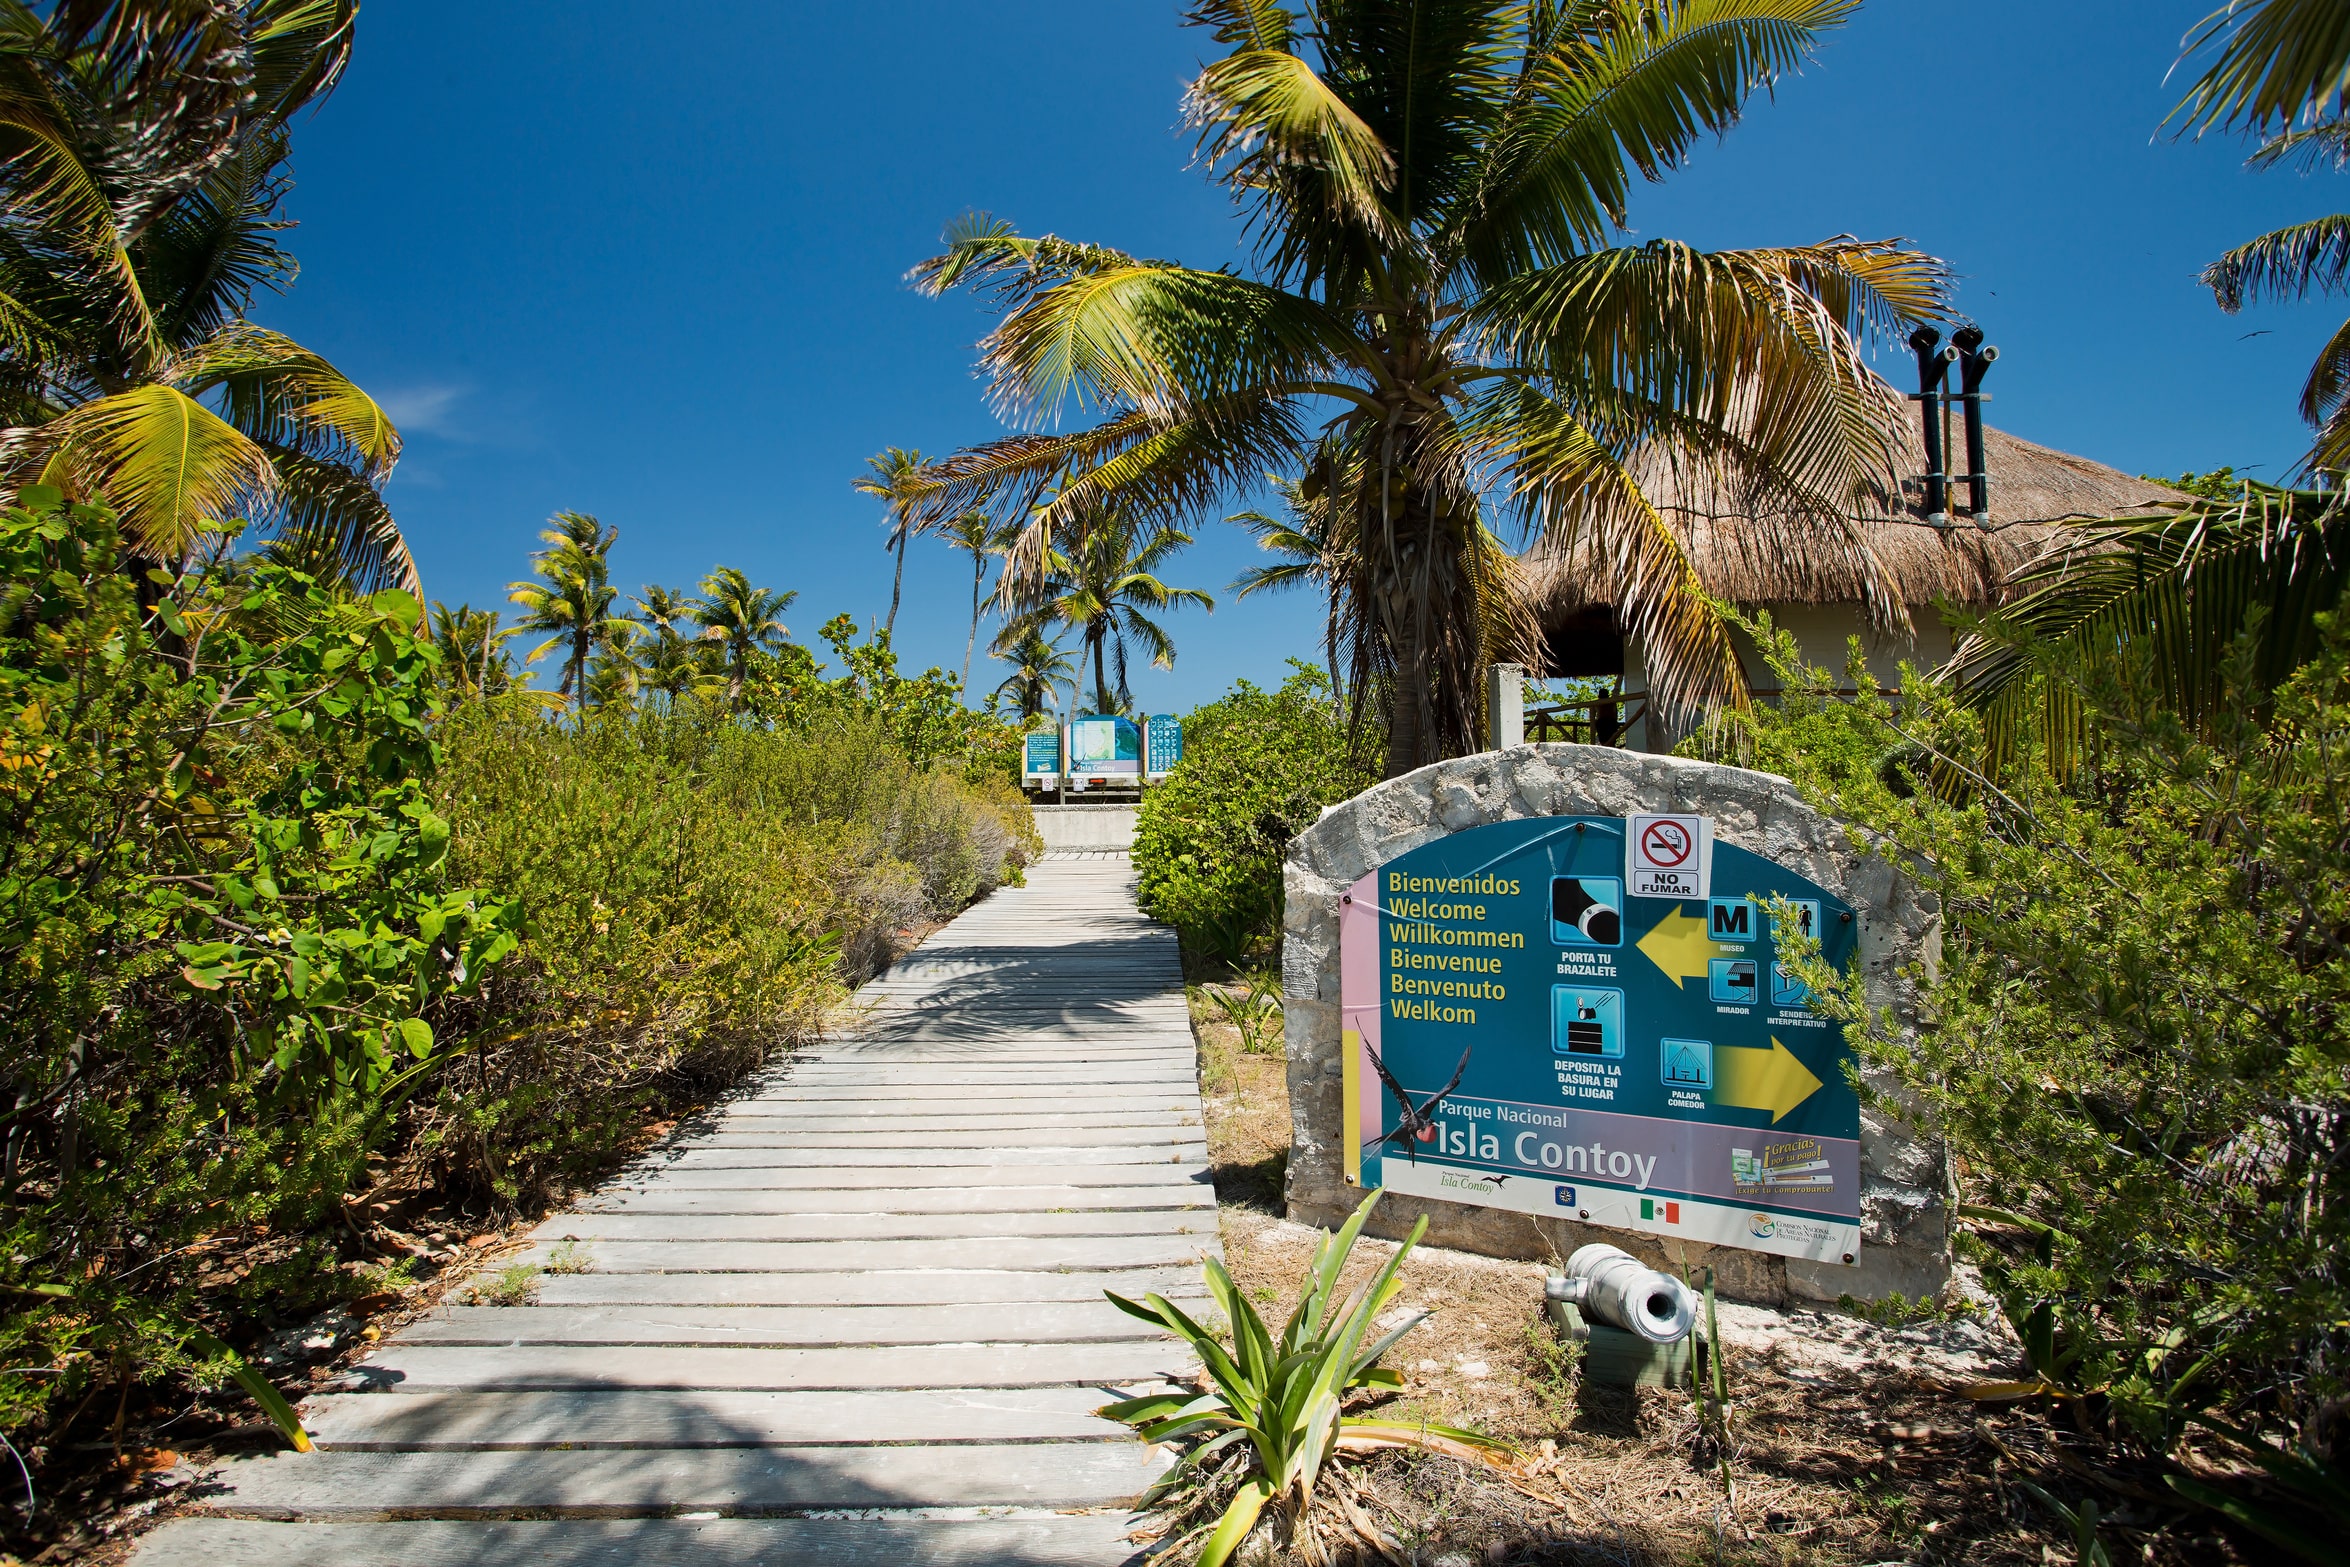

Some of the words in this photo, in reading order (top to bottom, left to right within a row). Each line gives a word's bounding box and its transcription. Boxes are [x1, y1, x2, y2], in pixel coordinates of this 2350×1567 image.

[1093, 764, 1115, 772] Contoy
[1389, 872, 1521, 895] Bienvenidos
[1654, 873, 1679, 885] NO
[1641, 884, 1691, 894] FUMAR
[1389, 897, 1486, 920] Welcome
[1714, 905, 1748, 933] M
[1389, 923, 1525, 949] Willkommen
[1720, 944, 1745, 952] MUSEO
[1391, 948, 1502, 973] Bienvenue
[1561, 952, 1599, 964] PORTA
[1598, 953, 1611, 964] TU
[1557, 964, 1617, 977] BRAZALETE
[1391, 973, 1506, 1000] Benvenuto
[1391, 998, 1476, 1024] Welkom
[1716, 1006, 1750, 1015] MIRADOR
[1767, 1017, 1827, 1028] INTERPRETATIVO
[1554, 1060, 1605, 1075] DEPOSITA
[1608, 1065, 1622, 1076] LA
[1557, 1072, 1600, 1087] BASURA
[1604, 1077, 1618, 1088] EN
[1561, 1085, 1576, 1097] SU
[1579, 1087, 1614, 1100] LUGAR
[1672, 1090, 1701, 1100] PALAPA
[1668, 1098, 1705, 1109] COMEDOR
[1439, 1099, 1491, 1121] Parque
[1497, 1106, 1567, 1128] Nacional
[1439, 1121, 1500, 1161] Isla
[1514, 1131, 1658, 1191] Contoy
[1771, 1155, 1785, 1166] por
[1787, 1154, 1796, 1162] tu
[1797, 1145, 1822, 1162] pago!
[1440, 1175, 1458, 1188] Isla
[1460, 1177, 1494, 1195] Contoy
[1762, 1186, 1771, 1194] tu
